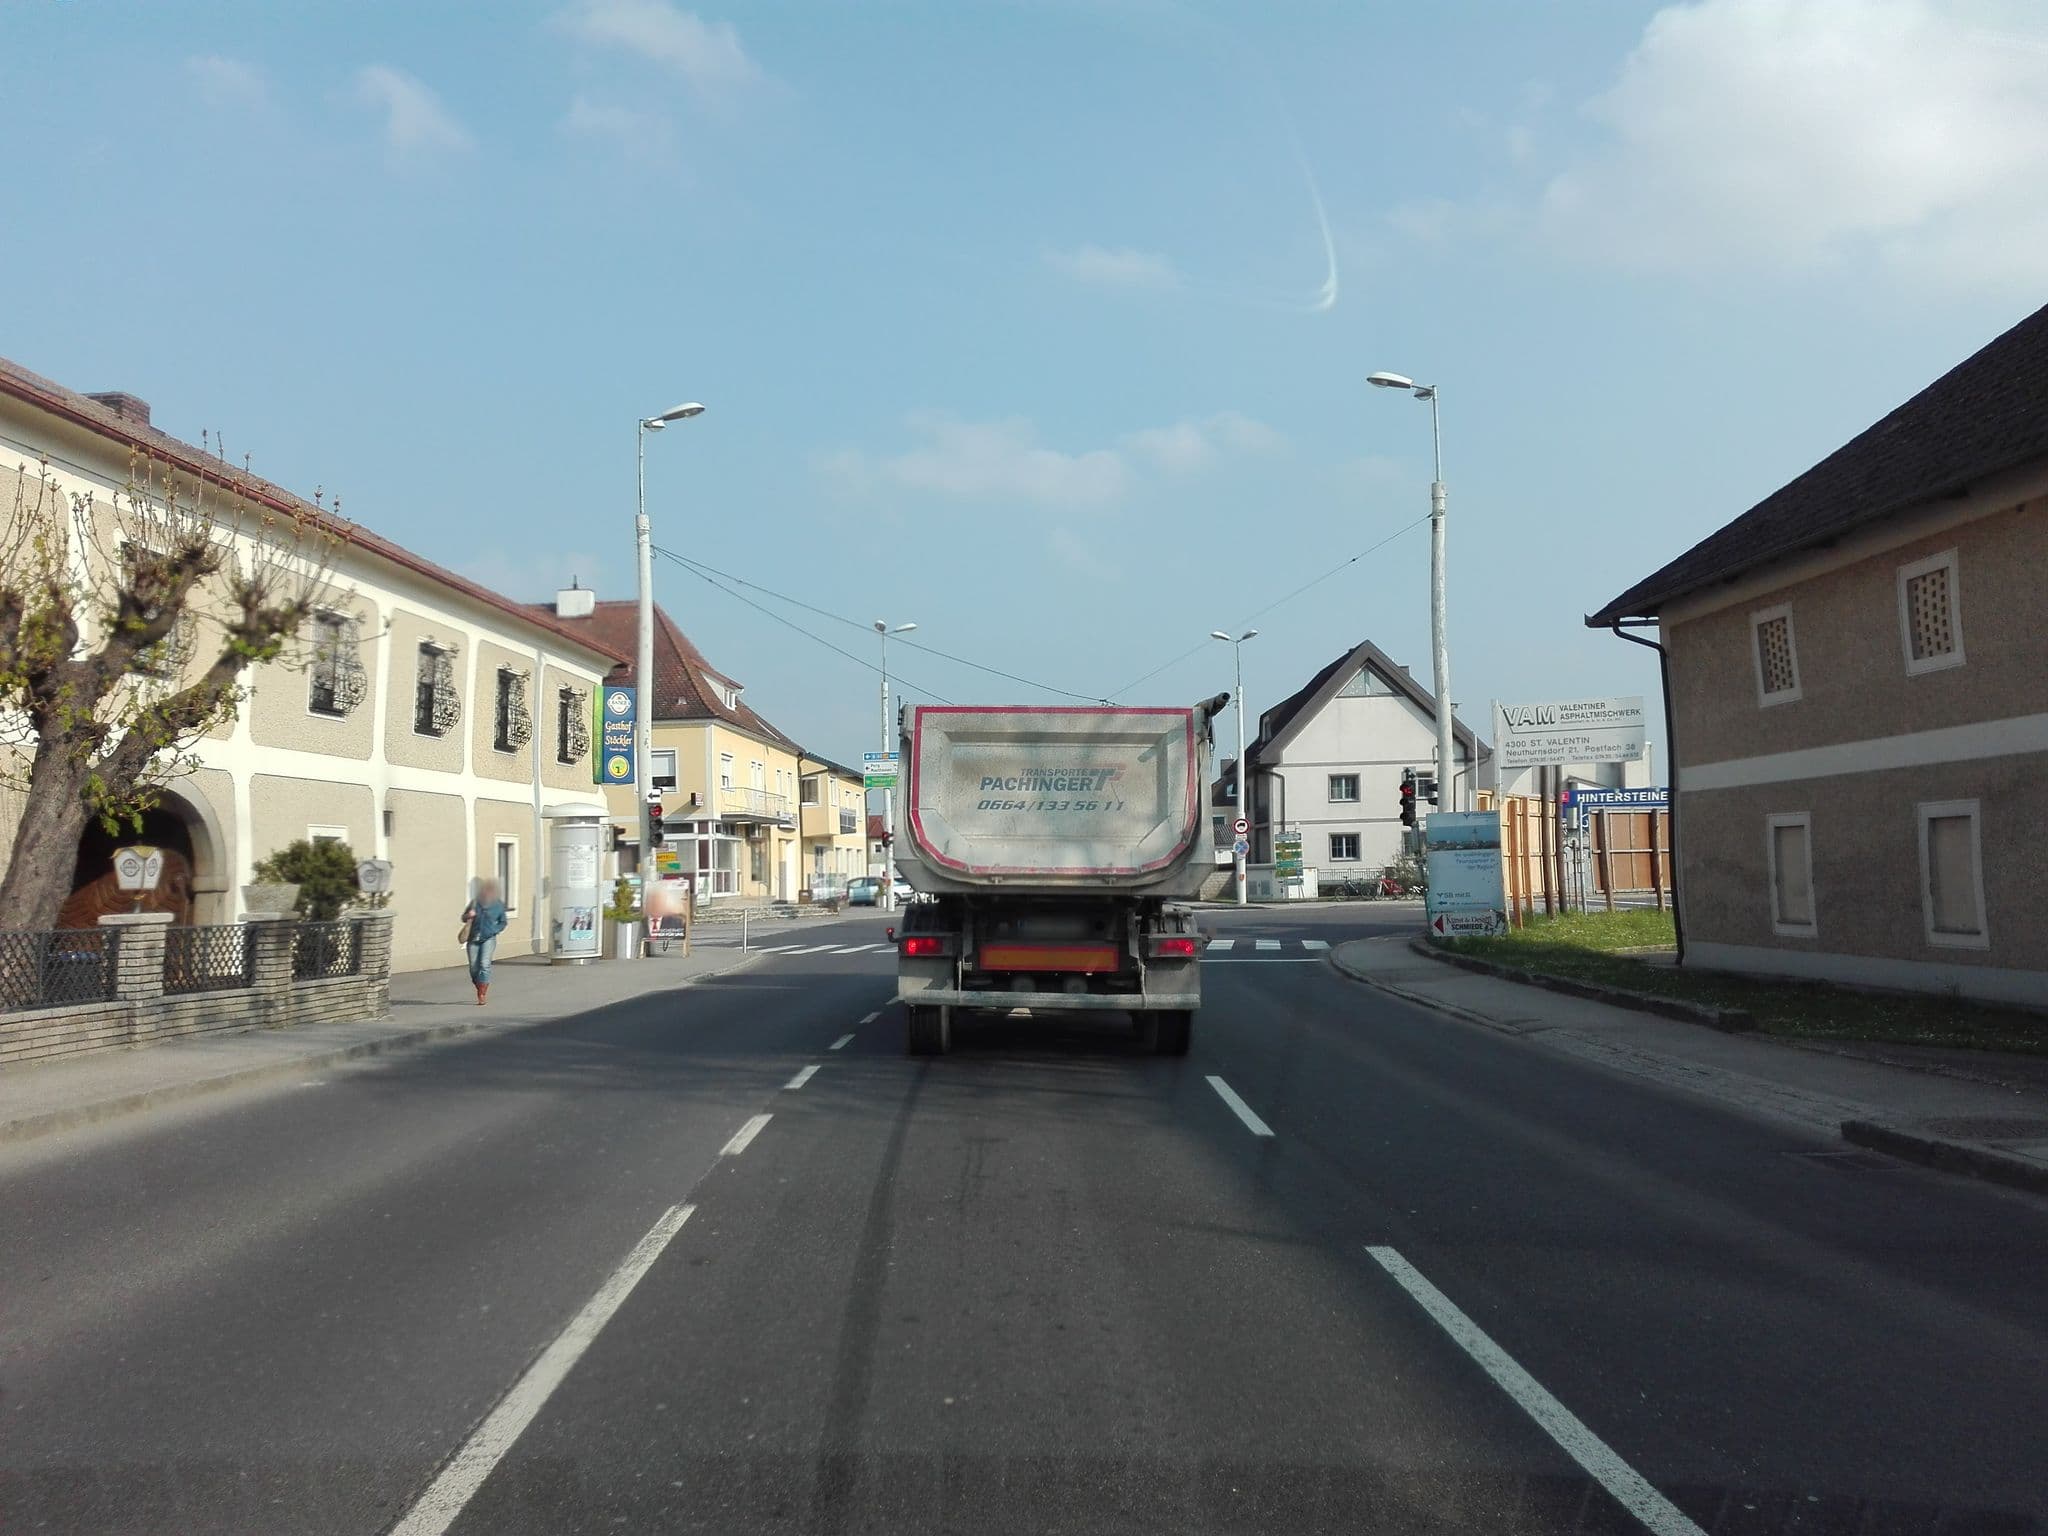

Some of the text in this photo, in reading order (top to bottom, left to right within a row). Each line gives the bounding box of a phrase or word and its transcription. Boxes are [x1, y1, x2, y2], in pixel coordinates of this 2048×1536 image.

[1559, 702, 1606, 711] VALENTINER
[1502, 704, 1556, 726] VAM
[1560, 708, 1641, 720] ASPHALTMISCHWERK
[605, 720, 633, 733] Gasthof
[604, 734, 633, 746] Stöckler
[1547, 737, 1590, 746] VALENTIN
[1585, 744, 1622, 753] Postfach
[1020, 768, 1089, 777] TRANSPORTE
